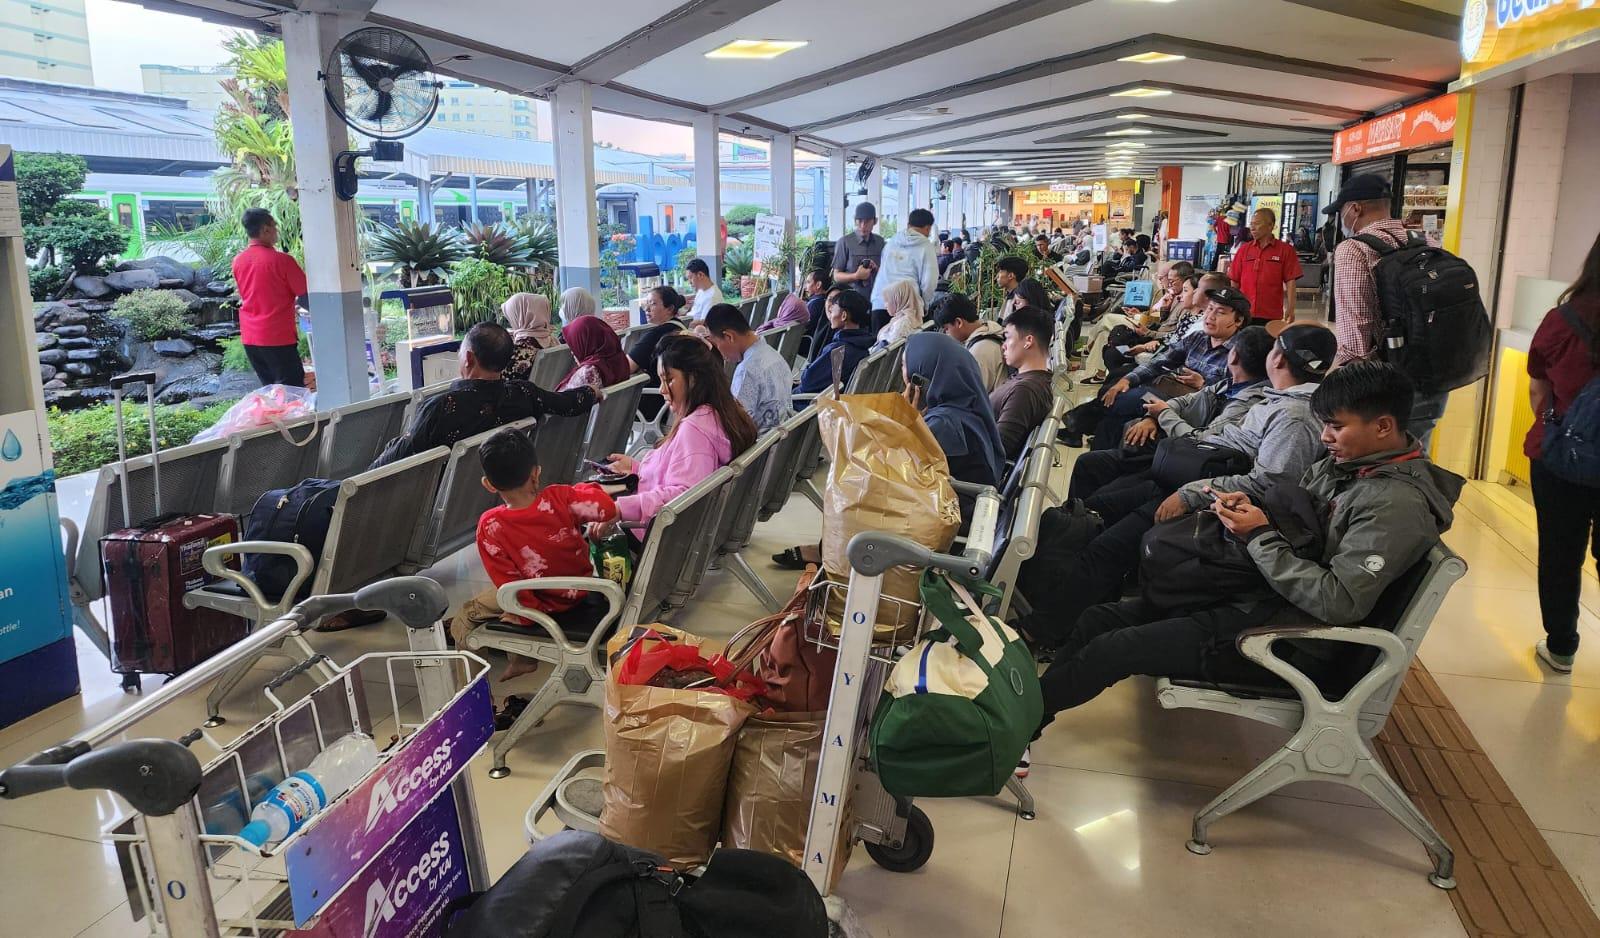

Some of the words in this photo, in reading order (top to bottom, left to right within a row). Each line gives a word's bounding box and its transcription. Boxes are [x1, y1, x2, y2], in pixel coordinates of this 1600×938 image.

[364, 738, 451, 836] Access
[429, 776, 439, 789] by
[439, 758, 453, 779] KAI
[363, 831, 450, 938] Access
[428, 874, 439, 892] by
[439, 854, 453, 880] KAI
